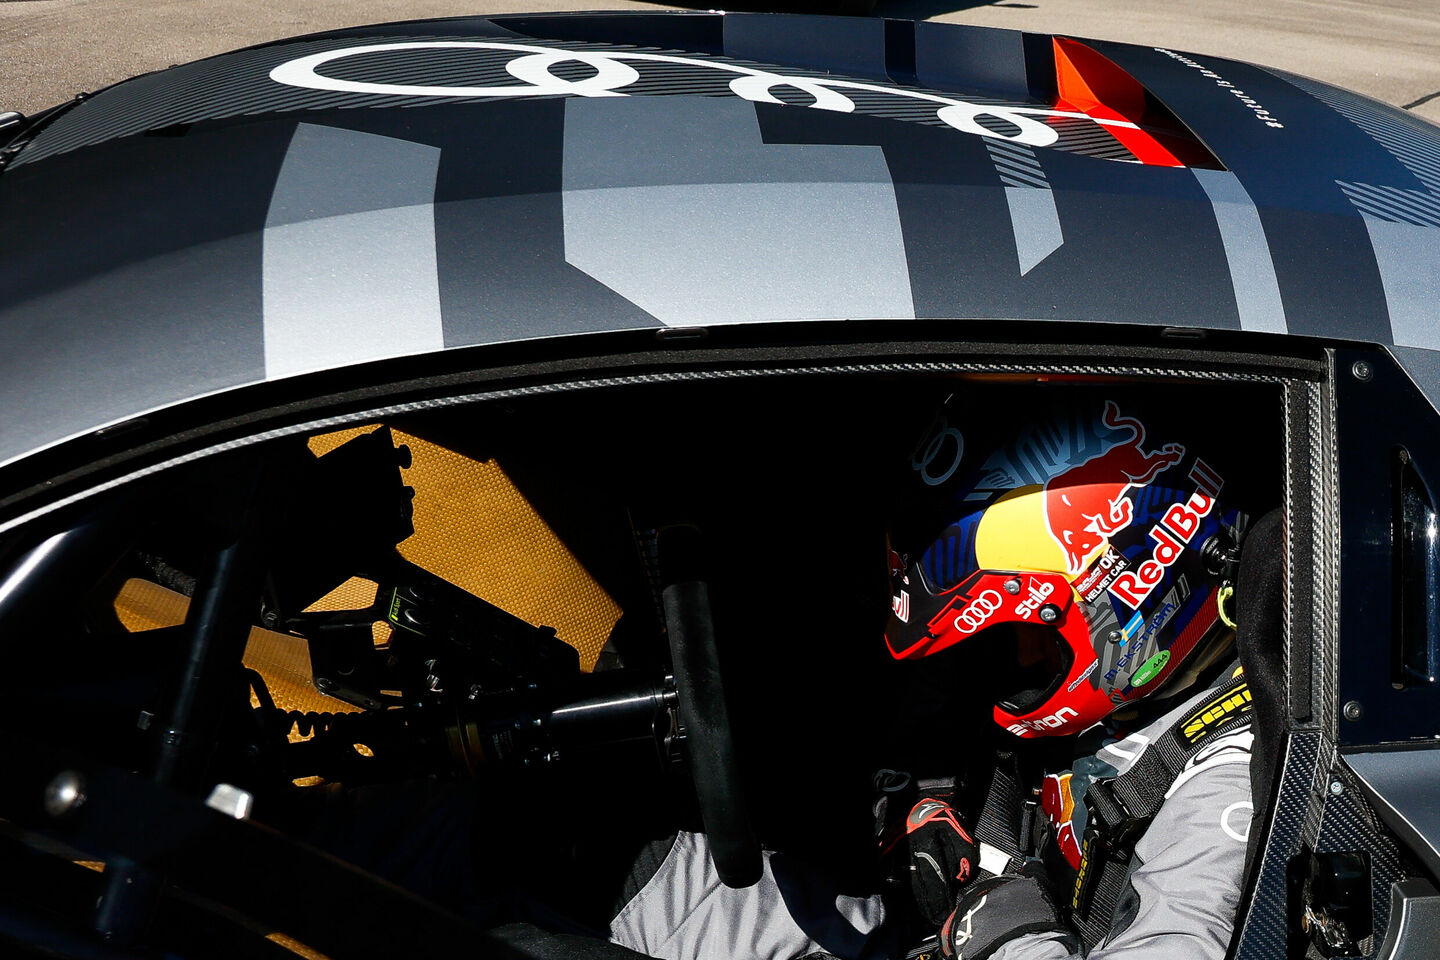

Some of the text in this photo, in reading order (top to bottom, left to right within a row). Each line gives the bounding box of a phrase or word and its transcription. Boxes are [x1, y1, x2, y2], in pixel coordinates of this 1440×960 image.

[1107, 458, 1224, 609] Red Bull
[1099, 549, 1121, 570] OK
[1084, 573, 1113, 603] HELMET
[1110, 560, 1127, 577] CAR
